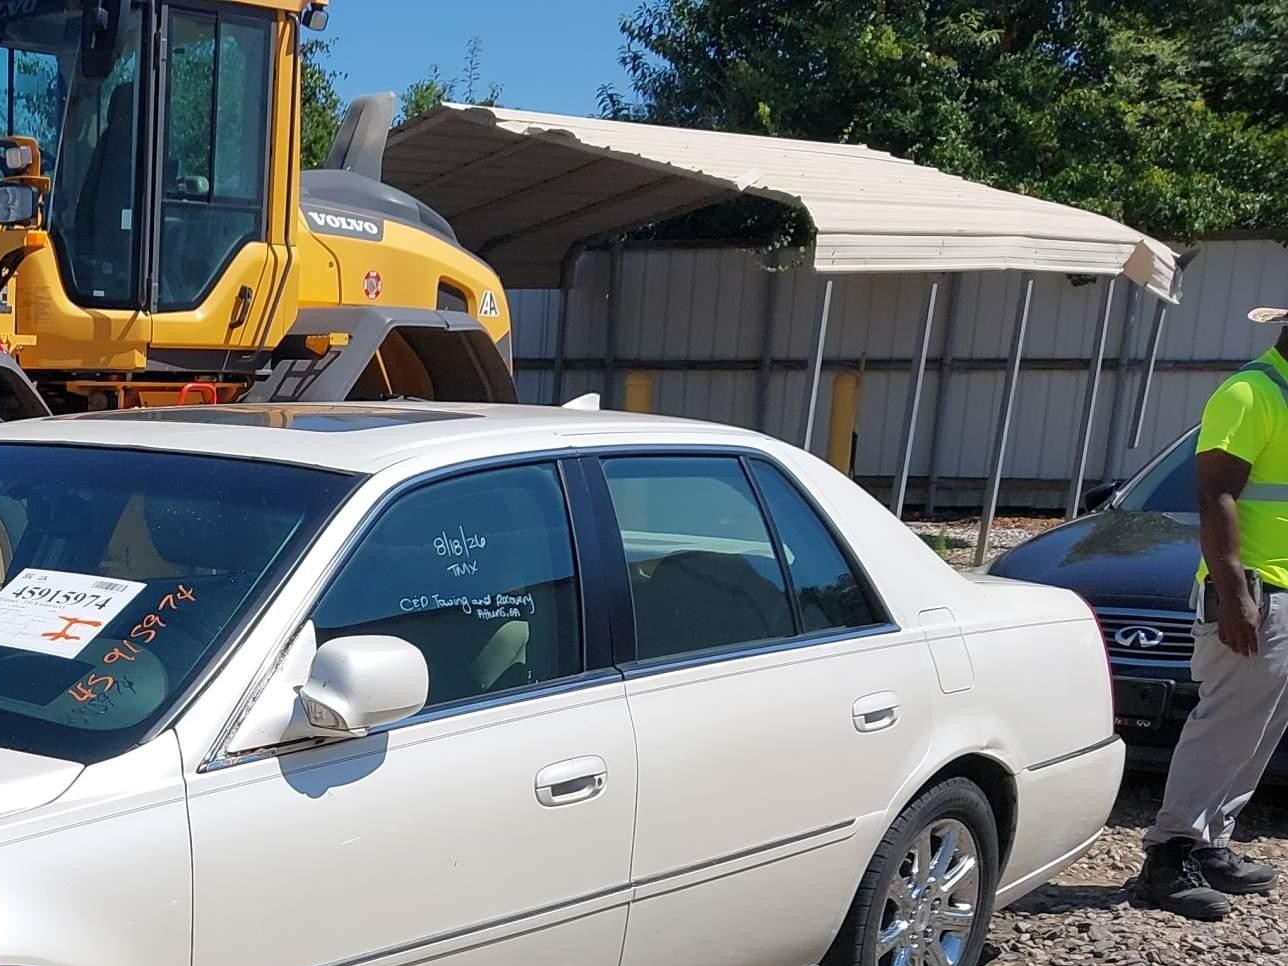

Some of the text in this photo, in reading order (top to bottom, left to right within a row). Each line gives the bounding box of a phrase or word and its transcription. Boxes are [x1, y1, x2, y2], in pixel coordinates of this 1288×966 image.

[308, 211, 378, 235] VOLVO
[433, 525, 487, 557] 8/18/26
[12, 585, 111, 610] 45915974
[431, 594, 472, 614] Towing
